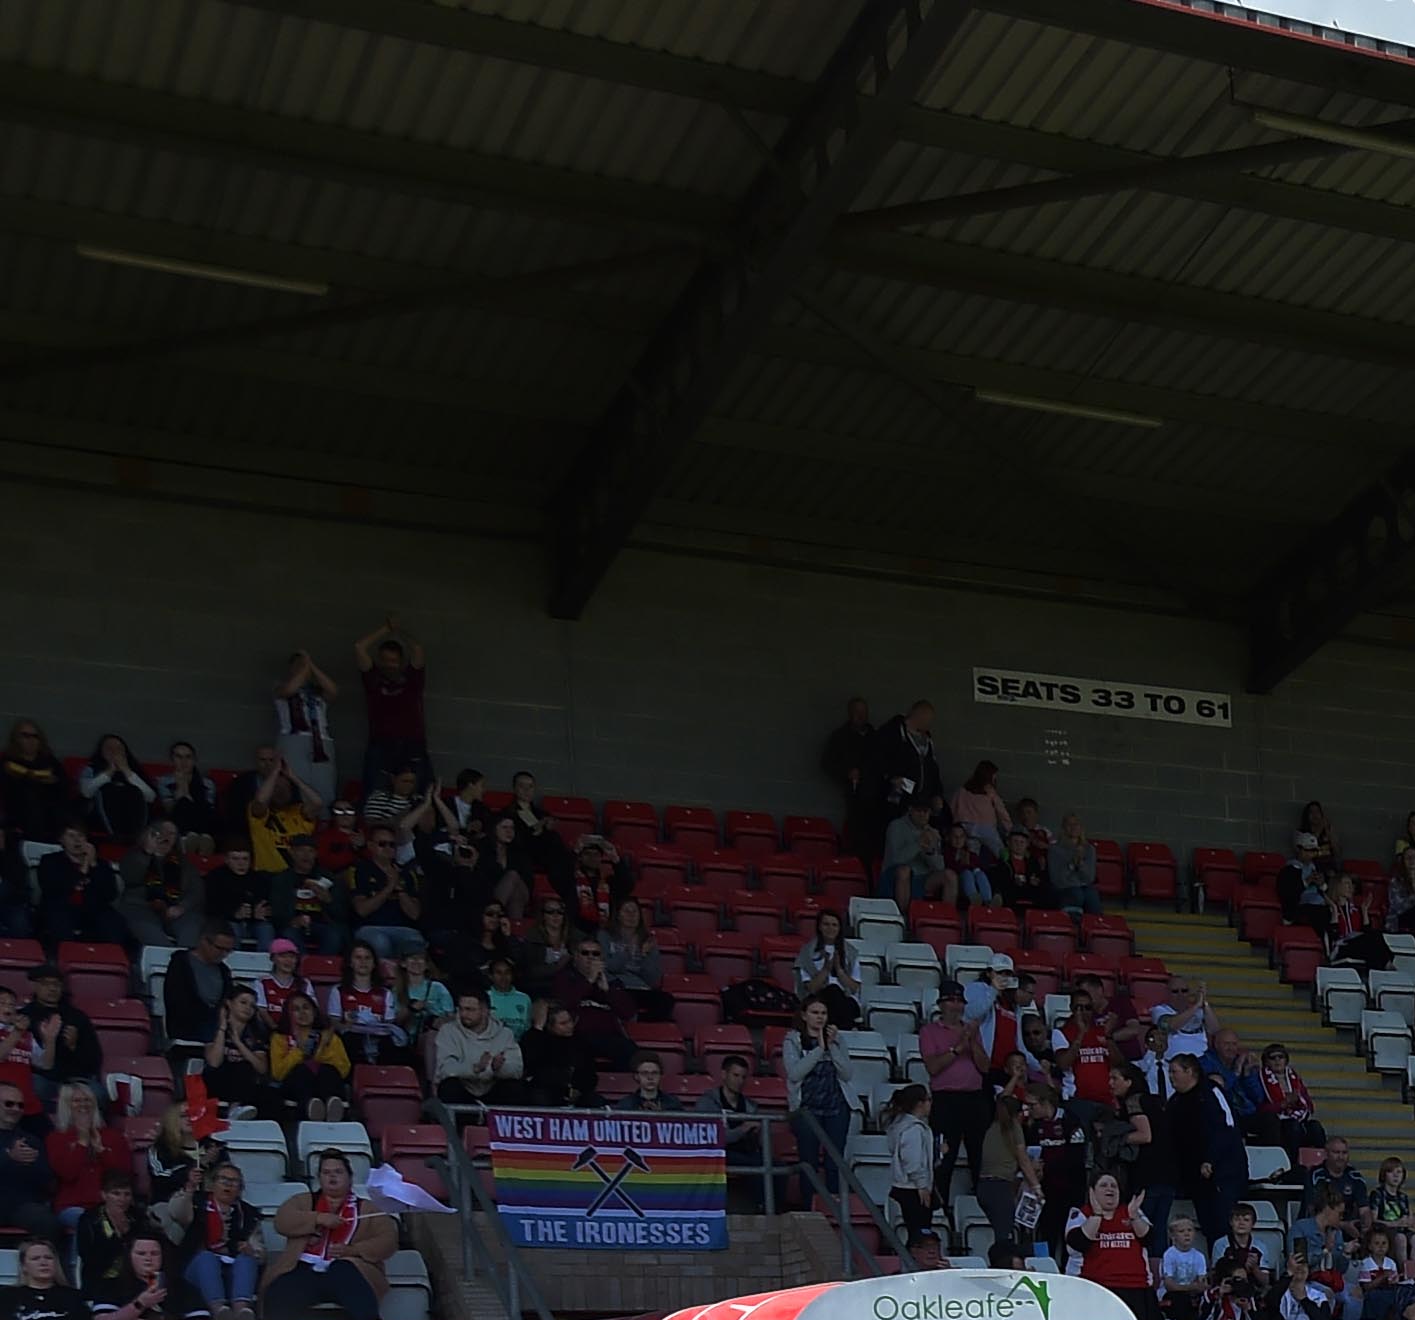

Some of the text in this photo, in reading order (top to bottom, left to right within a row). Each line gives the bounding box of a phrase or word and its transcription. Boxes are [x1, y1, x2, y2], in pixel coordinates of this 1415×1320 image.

[977, 675, 1229, 719] SEATS 33 TO 61
[495, 1114, 718, 1146] WEST HAM UNITED WOMEN
[519, 1219, 711, 1245] THE IRONESSES
